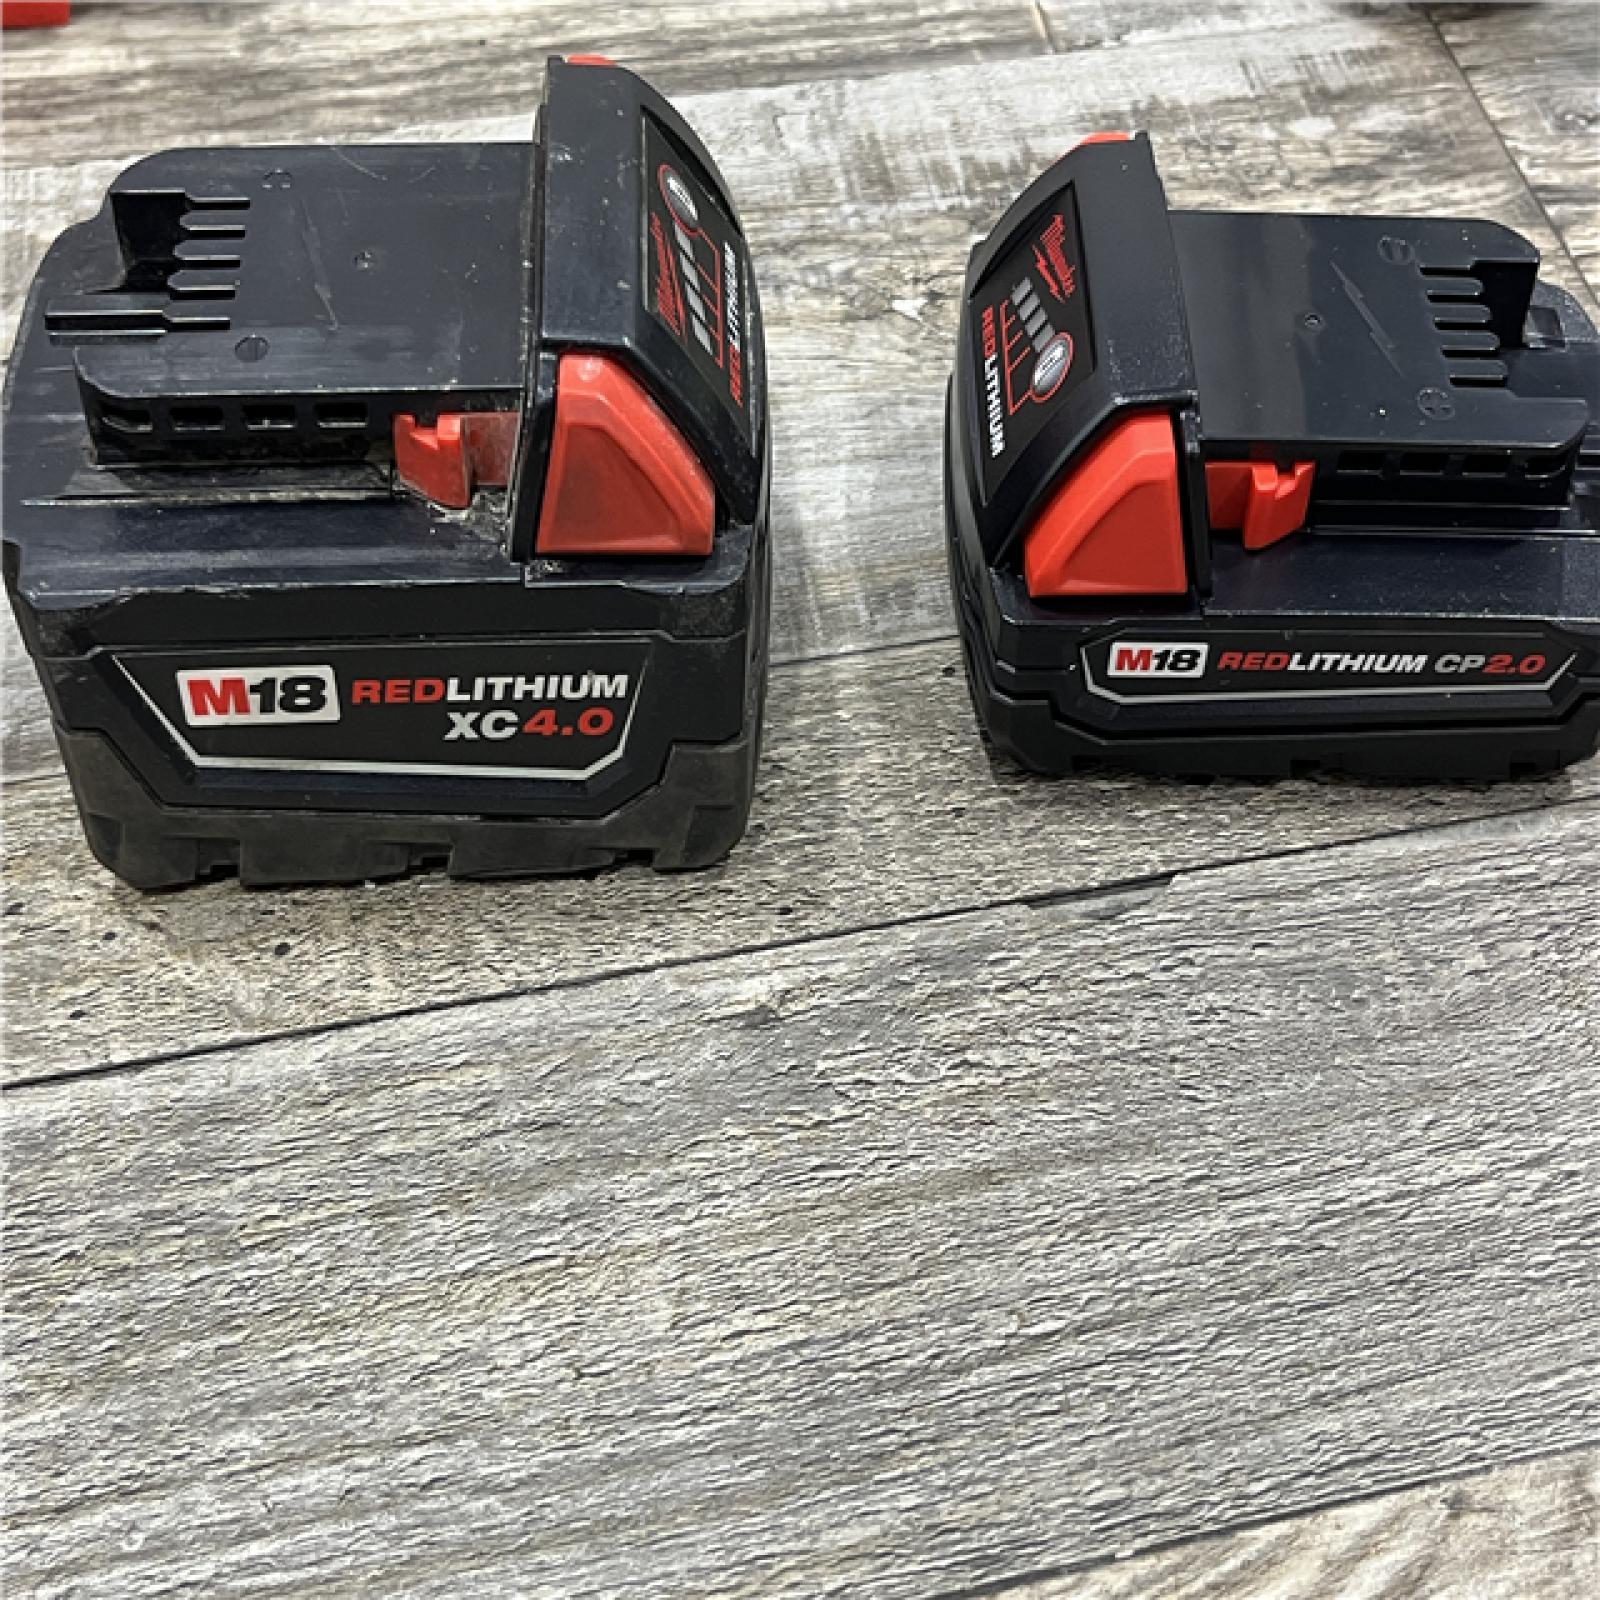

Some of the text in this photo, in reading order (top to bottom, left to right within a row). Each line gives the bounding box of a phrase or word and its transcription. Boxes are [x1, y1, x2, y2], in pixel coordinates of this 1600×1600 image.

[1116, 649, 1546, 674] M18 REDLITHIUM CP2.0
[187, 674, 628, 716] M18 REDLITHIUM
